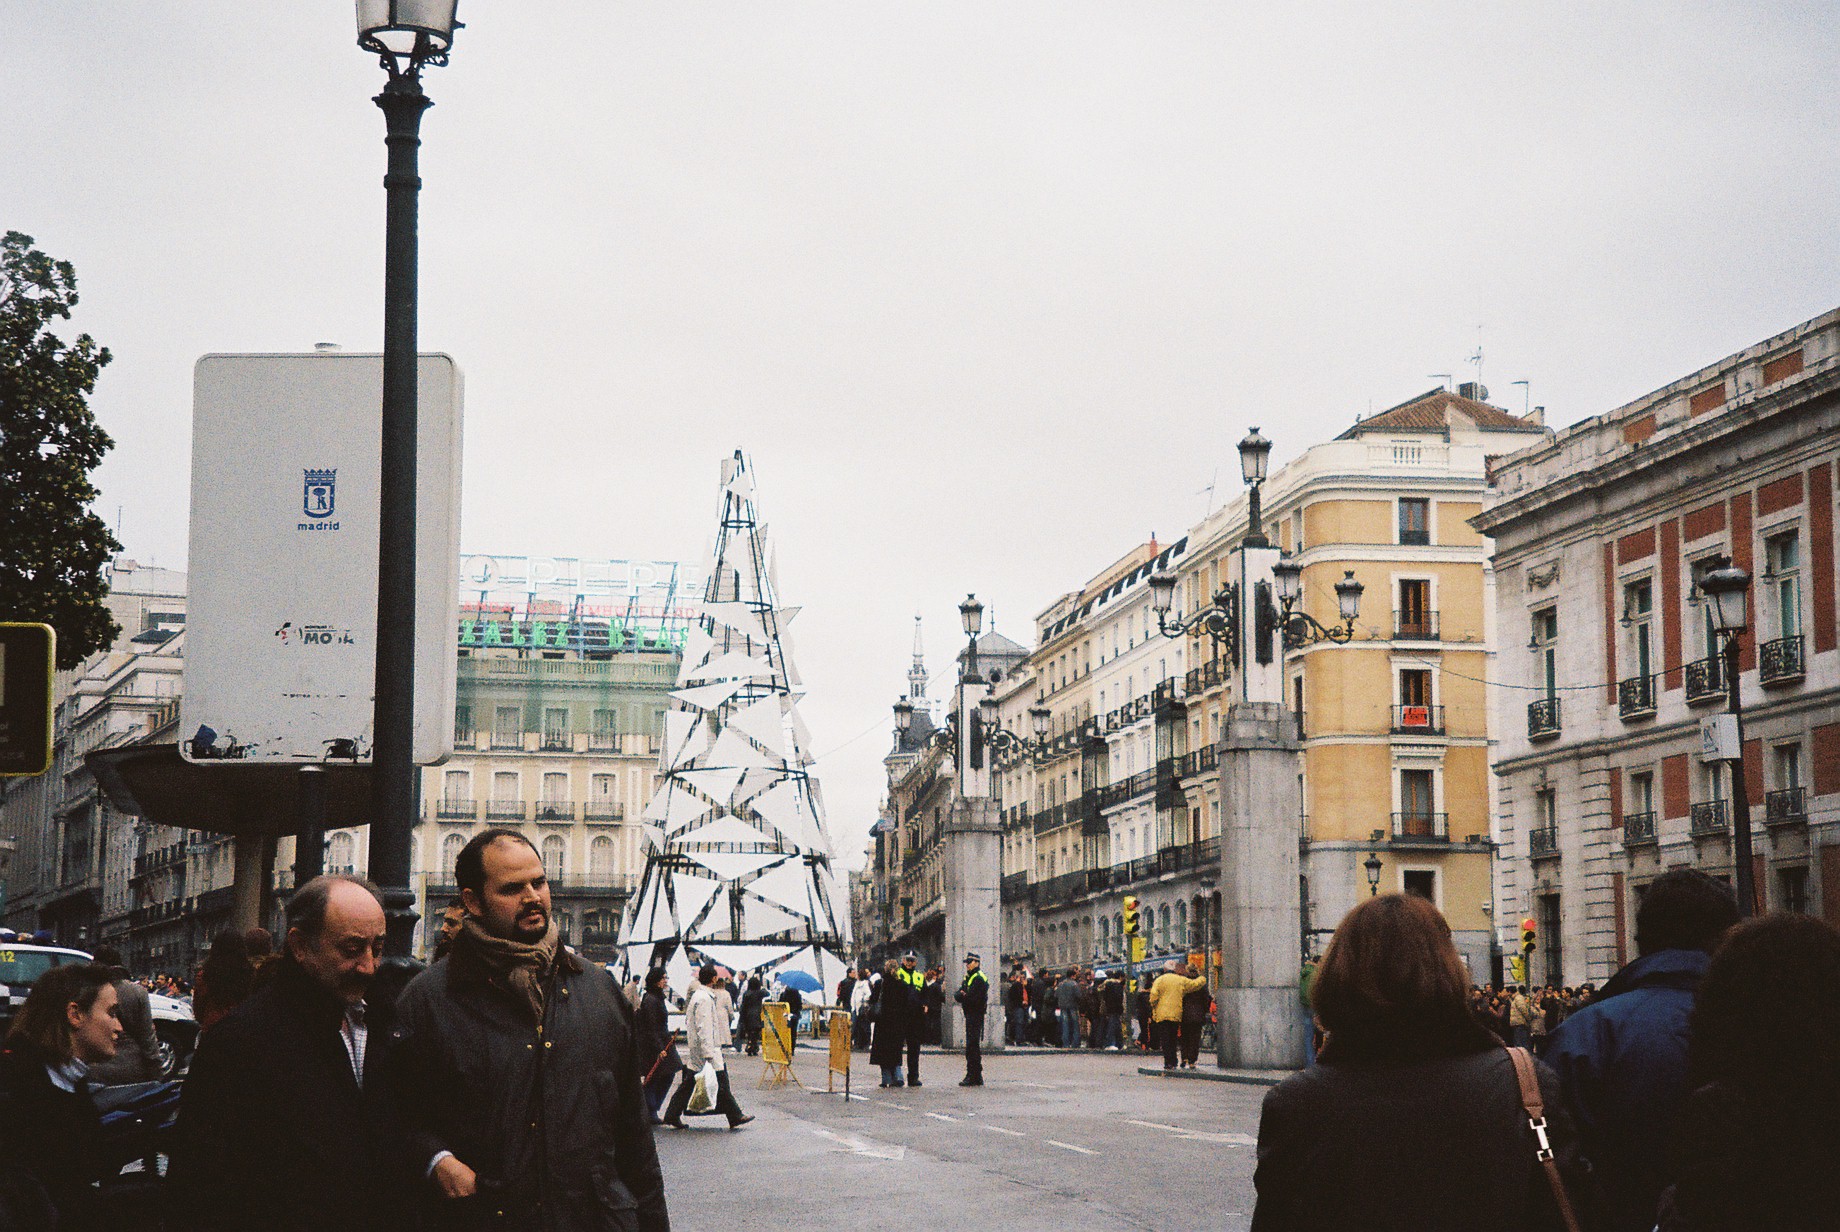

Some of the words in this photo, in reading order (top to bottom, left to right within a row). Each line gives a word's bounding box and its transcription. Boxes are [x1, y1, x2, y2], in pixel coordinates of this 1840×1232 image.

[297, 521, 340, 531] madrid
[574, 603, 709, 619] EMBOTELLAD
[460, 619, 568, 647] ZALEZ
[608, 617, 712, 650] BYAS
